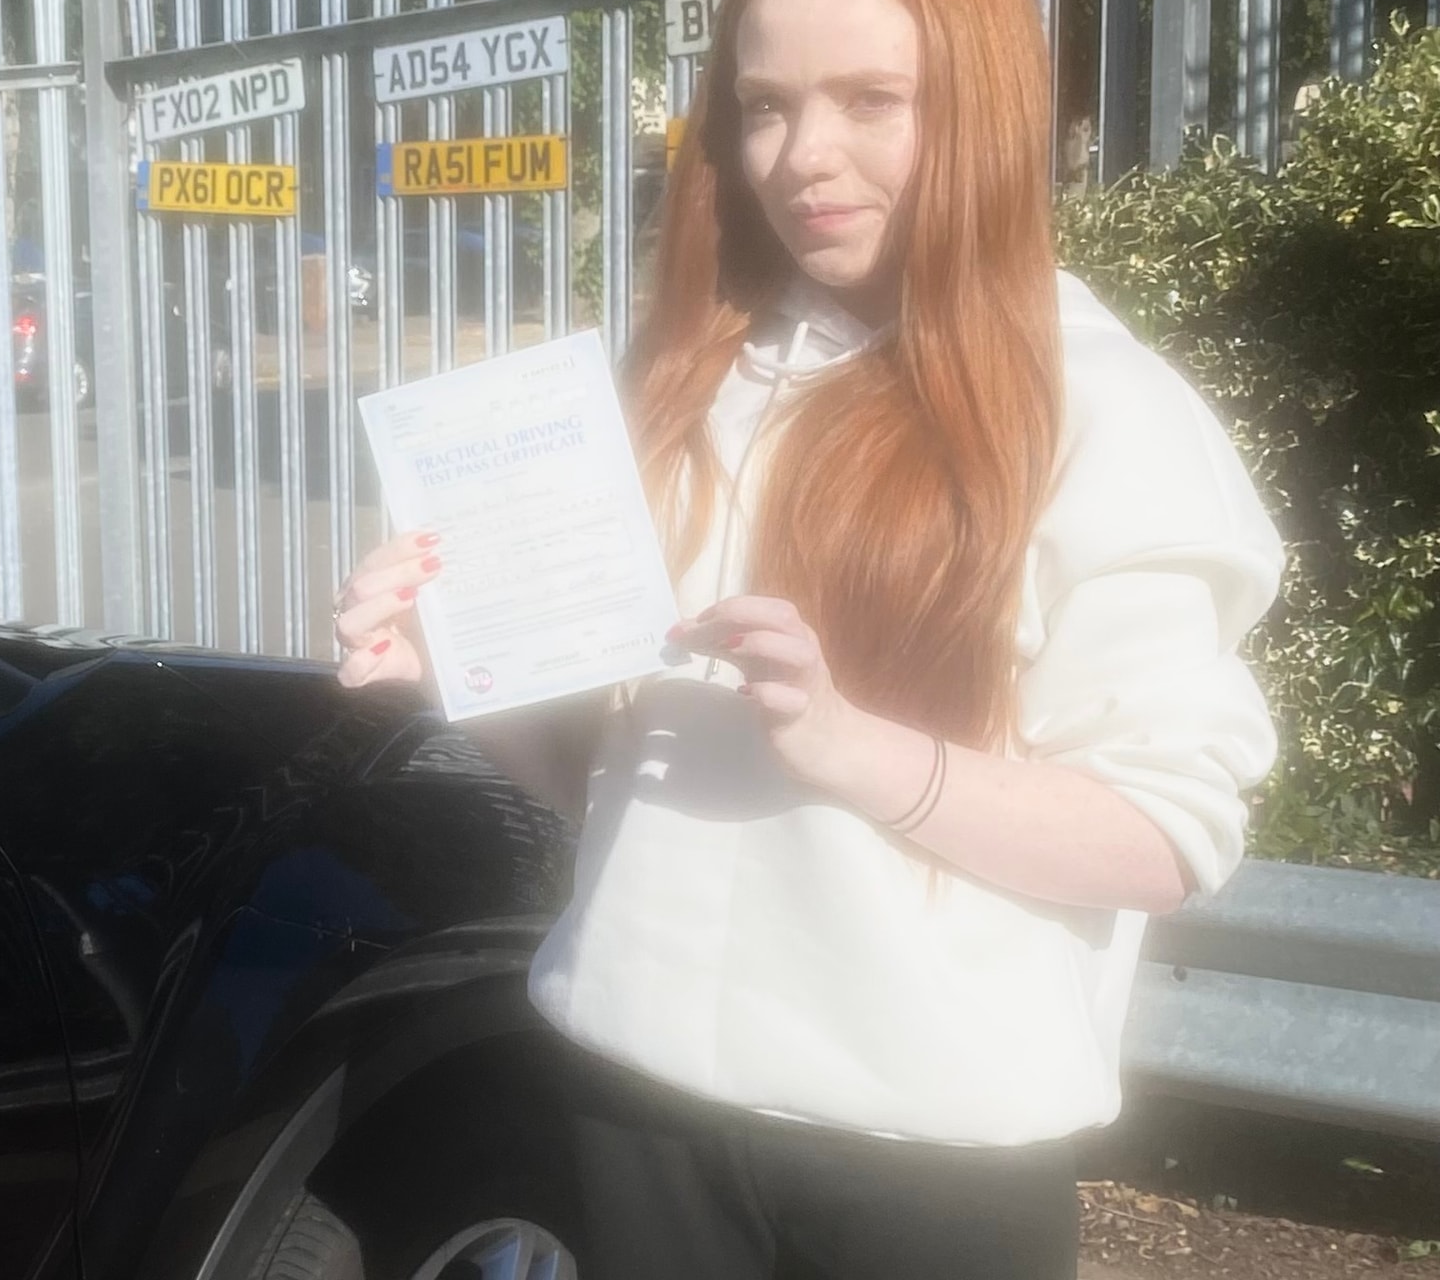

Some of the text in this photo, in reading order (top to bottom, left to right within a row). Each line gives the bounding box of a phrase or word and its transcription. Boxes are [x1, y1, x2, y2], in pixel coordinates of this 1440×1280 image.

[389, 26, 552, 94] AD54 YGX
[152, 69, 290, 133] FX02 NPD
[159, 167, 284, 208] PX61 OCR
[404, 141, 551, 186] RA51 FUM
[415, 414, 583, 474] PRACTICAL DRIVING
[419, 470, 452, 488] TEST
[456, 458, 491, 479] PASS
[492, 431, 586, 468] CERTIFICATE
